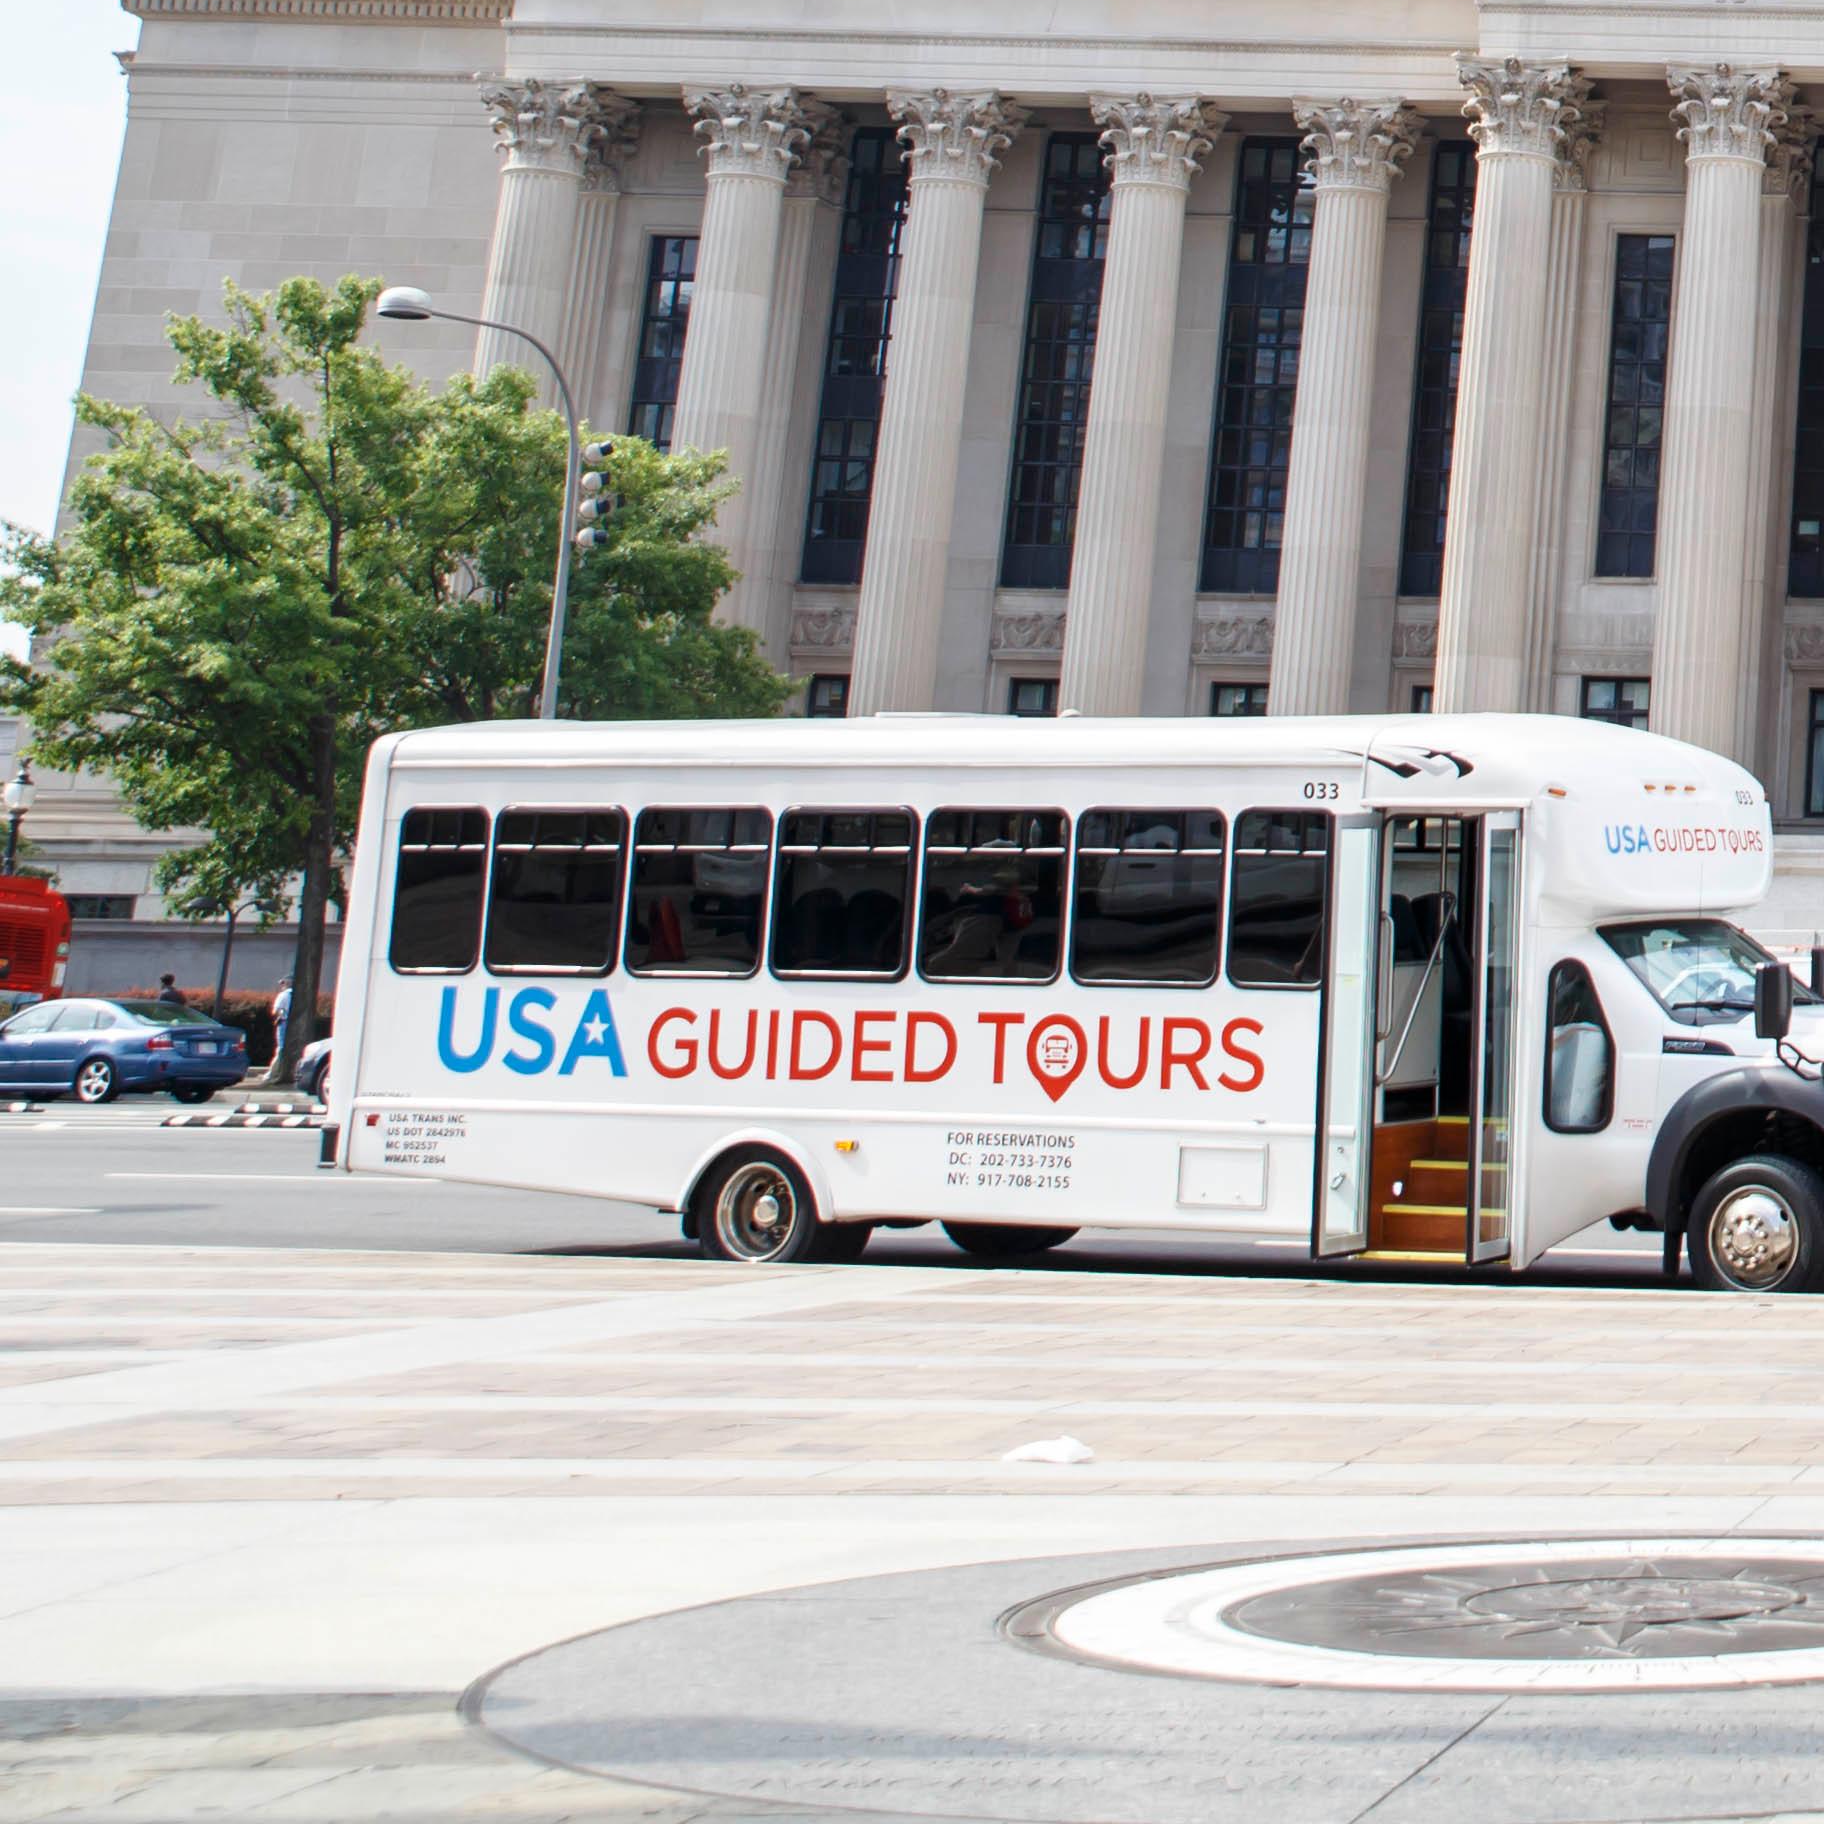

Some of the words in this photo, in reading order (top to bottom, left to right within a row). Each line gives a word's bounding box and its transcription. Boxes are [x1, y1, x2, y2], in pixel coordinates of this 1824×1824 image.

[1304, 782, 1339, 799] 033
[1605, 824, 1651, 854] USA
[1654, 828, 1717, 852] GUIDED
[1719, 828, 1763, 855] TOURS
[437, 985, 628, 1077] USA
[647, 1006, 958, 1082] GUIDED
[978, 1011, 1265, 1103] TOURS
[389, 1114, 408, 1123] USA
[412, 1114, 444, 1123] TRANS
[448, 1115, 467, 1124] INC.
[387, 1128, 400, 1136] US
[404, 1128, 423, 1136] DOT
[947, 1132, 973, 1145] FOR
[976, 1133, 1075, 1148] RESERVATIONS
[386, 1141, 400, 1149] MC
[385, 1155, 420, 1163] WMATC
[949, 1152, 972, 1165] DC:
[980, 1153, 1072, 1168] 202-733-7376
[947, 1172, 970, 1186] NY:
[978, 1173, 1070, 1189] 917-708-2155
